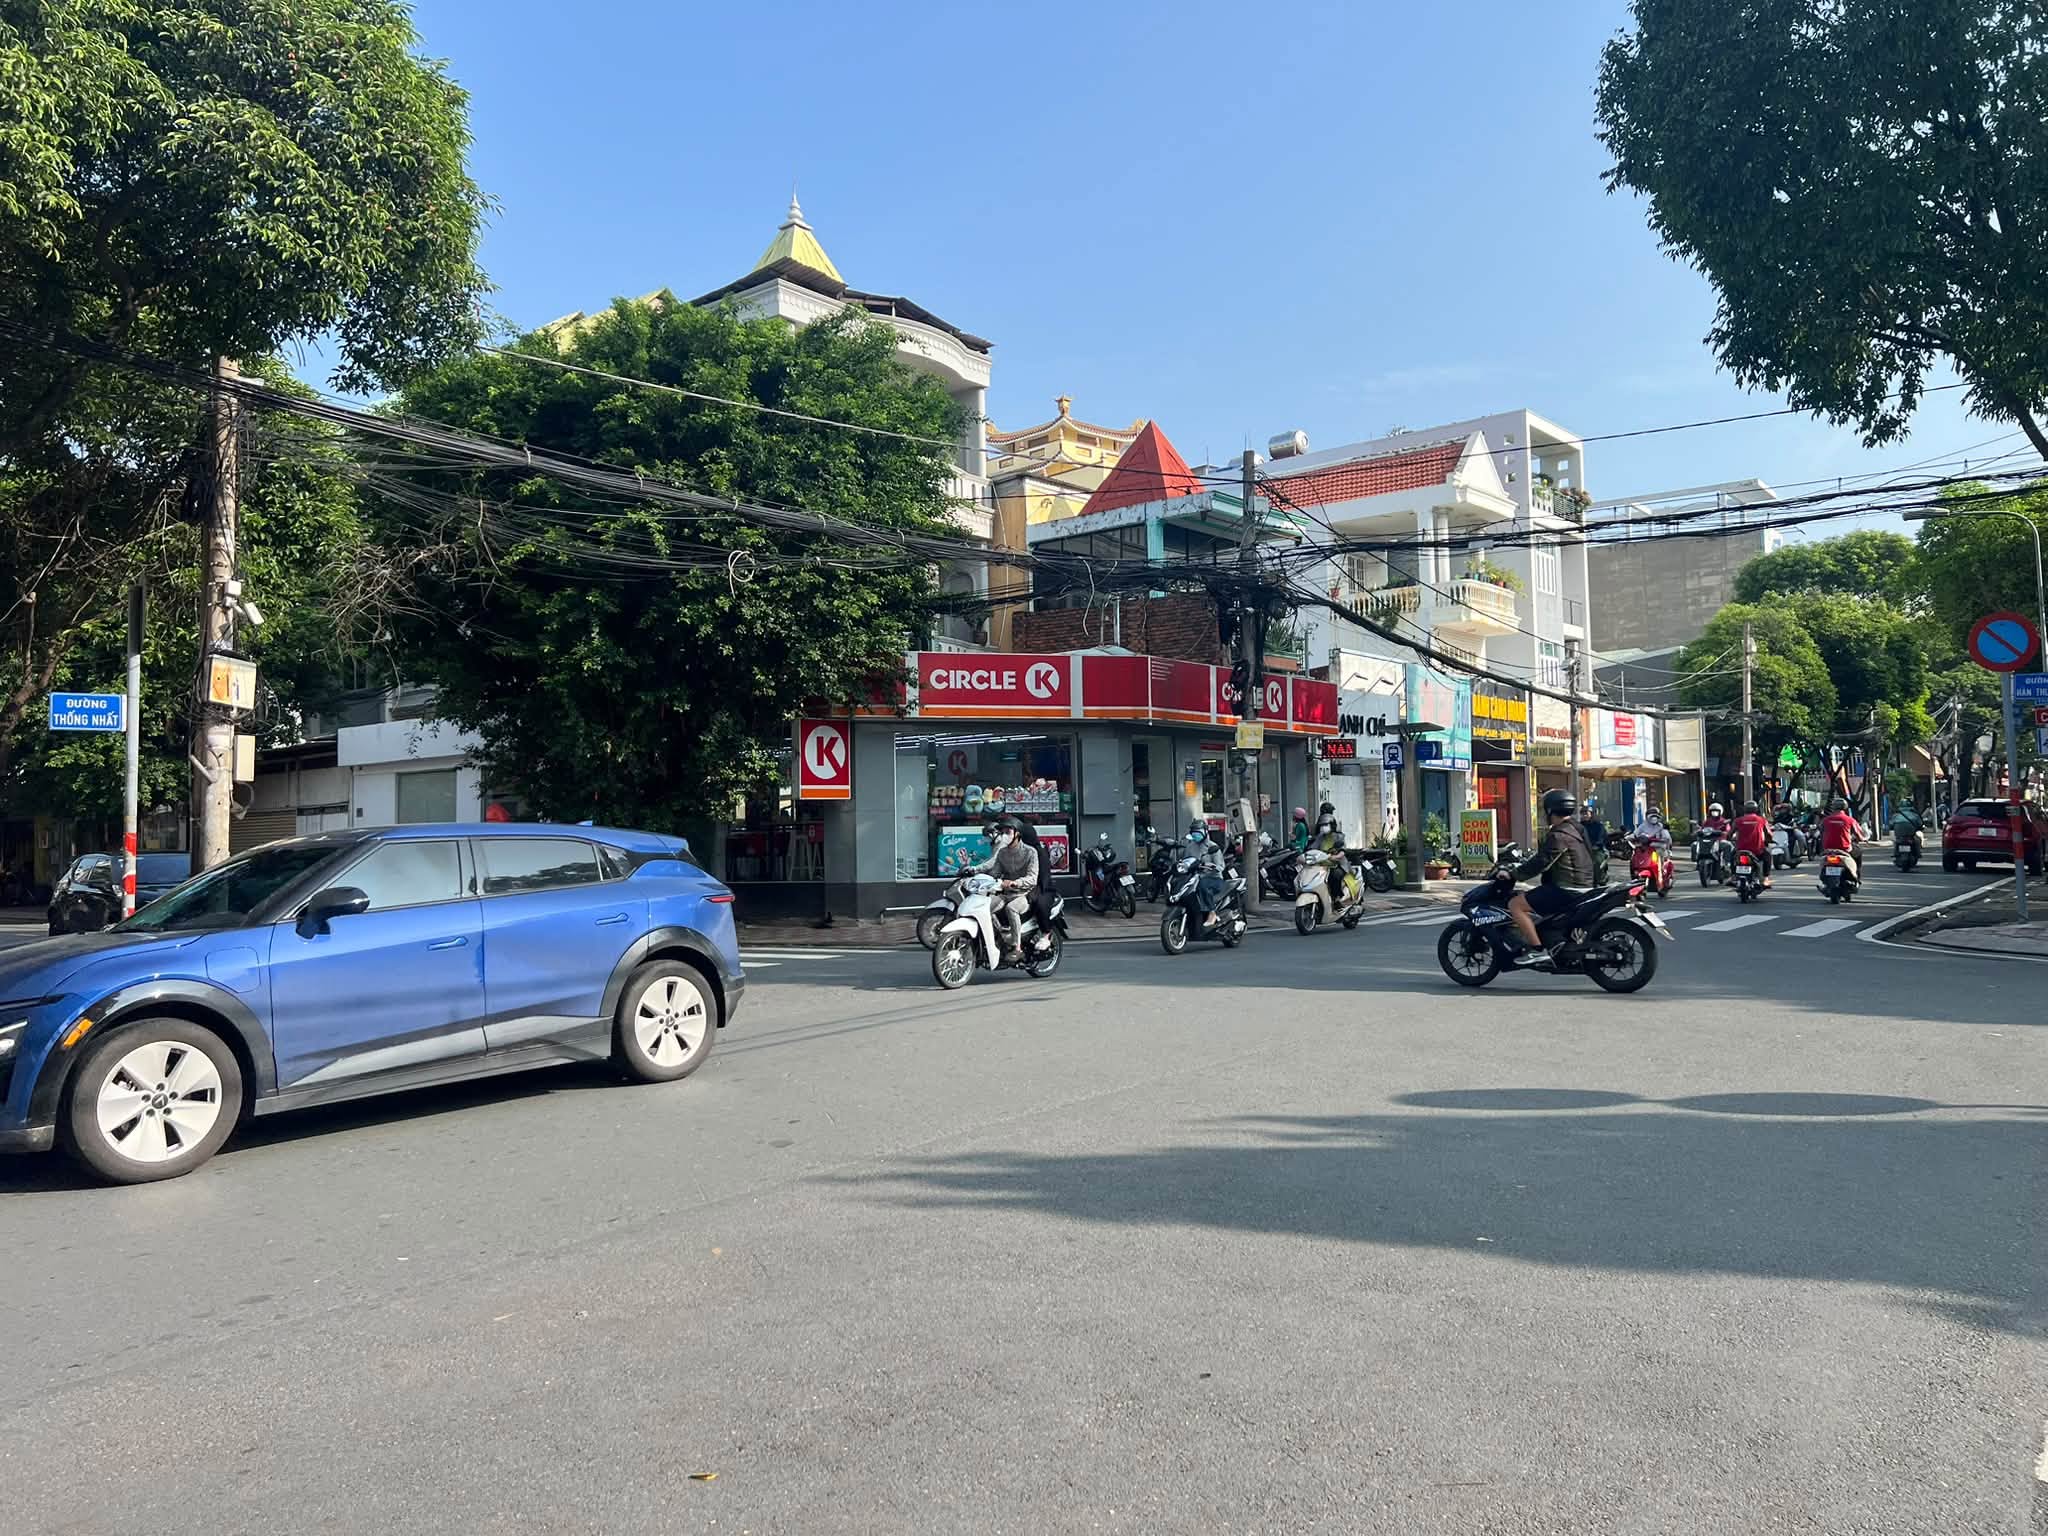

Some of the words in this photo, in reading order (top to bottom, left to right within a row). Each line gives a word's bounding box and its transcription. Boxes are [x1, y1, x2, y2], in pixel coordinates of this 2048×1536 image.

[929, 669, 1016, 690] CIRCLE
[1030, 665, 1059, 698] K
[2025, 676, 2048, 686] ĐƯỜN
[66, 697, 107, 709] ĐƯỜNG
[1269, 684, 1282, 711] K
[53, 710, 89, 726] THỐNG
[92, 711, 118, 727] NHẤT
[1339, 713, 1364, 737] ẠNH
[810, 730, 845, 778] K
[1463, 830, 1490, 843] CHAY
